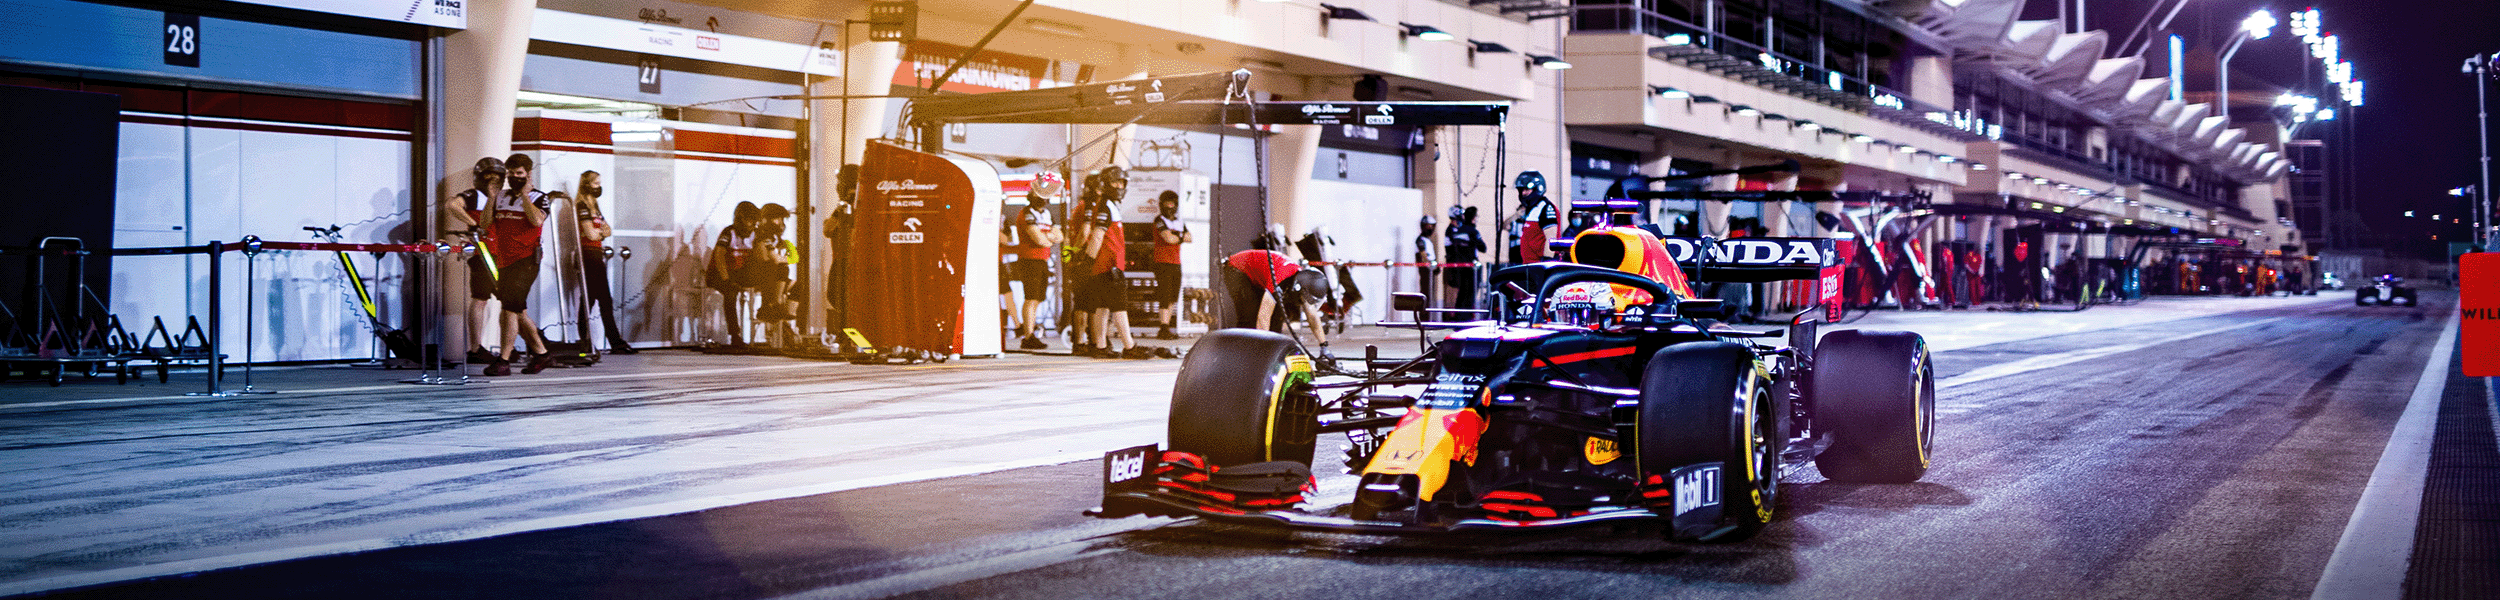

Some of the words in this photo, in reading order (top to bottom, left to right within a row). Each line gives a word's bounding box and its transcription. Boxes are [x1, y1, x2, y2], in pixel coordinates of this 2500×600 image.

[168, 24, 195, 55] 28
[640, 61, 659, 85] 27
[1667, 238, 1821, 264] ONDA
[2461, 308, 2500, 320] WIL
[1110, 451, 1145, 483] telcel
[1674, 469, 1702, 517] Mobil
